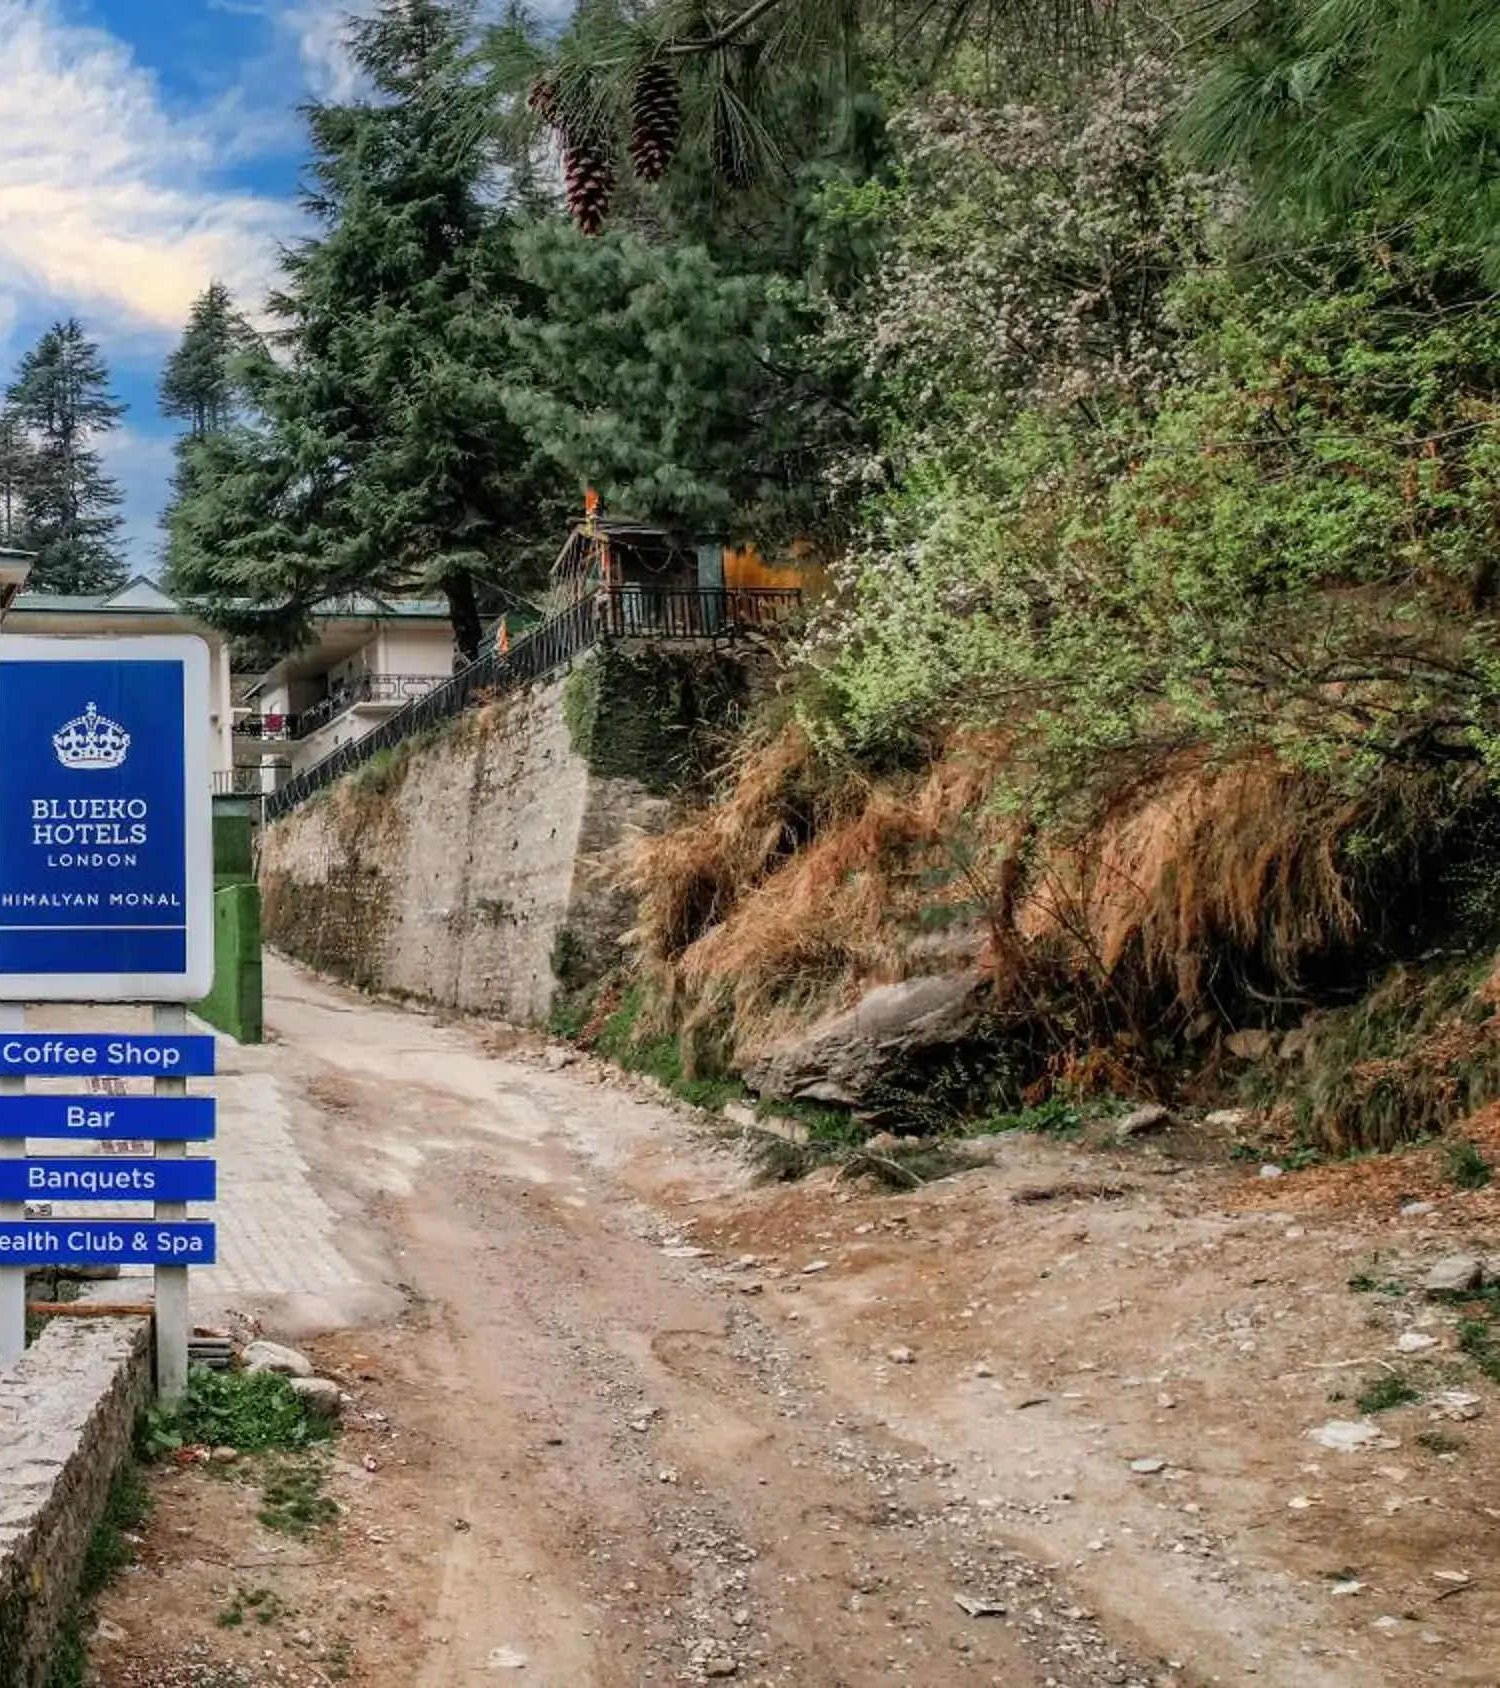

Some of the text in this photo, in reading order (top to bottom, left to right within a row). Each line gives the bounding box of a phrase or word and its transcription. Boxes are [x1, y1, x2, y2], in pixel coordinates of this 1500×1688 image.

[31, 799, 147, 820] BLUEKO
[32, 823, 147, 845] HOTELS
[47, 853, 137, 867] LONDON
[2, 893, 181, 907] HIMALYAN MONAL
[3, 1041, 181, 1069] Coffee Shop
[67, 1105, 115, 1128] Bar
[28, 1167, 155, 1192] Banquets
[67, 1231, 124, 1251] Club
[131, 1231, 149, 1251] &
[157, 1231, 203, 1255] Spa
